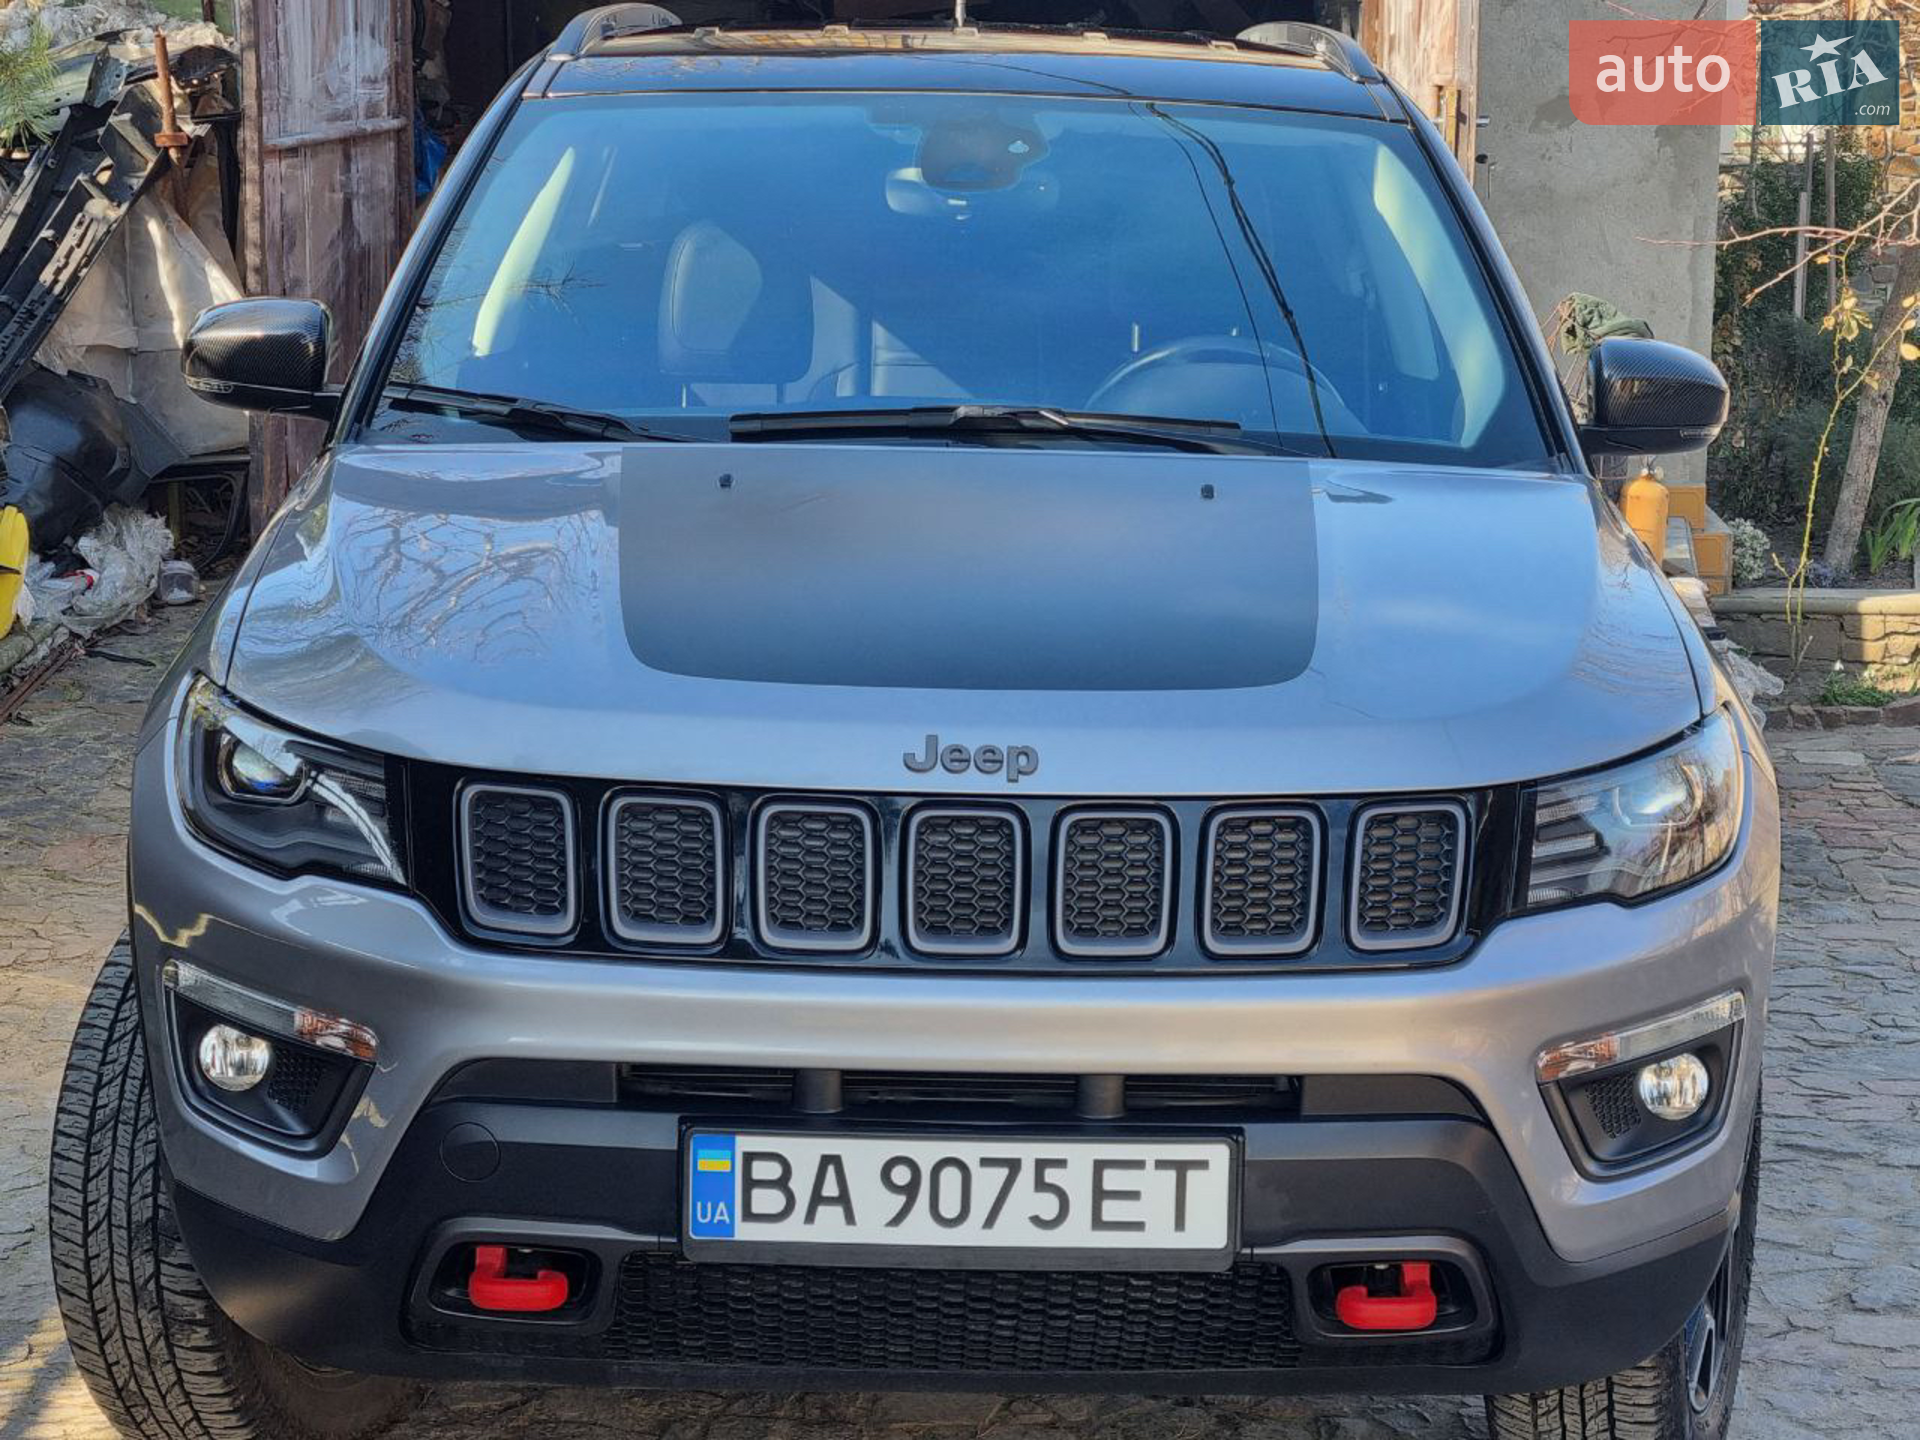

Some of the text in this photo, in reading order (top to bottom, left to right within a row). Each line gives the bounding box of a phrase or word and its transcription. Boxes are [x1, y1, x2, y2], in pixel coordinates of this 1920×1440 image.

[903, 734, 1039, 783] Jeep
[696, 1201, 731, 1224] UA
[741, 1151, 1209, 1232] BA 9075 ET
